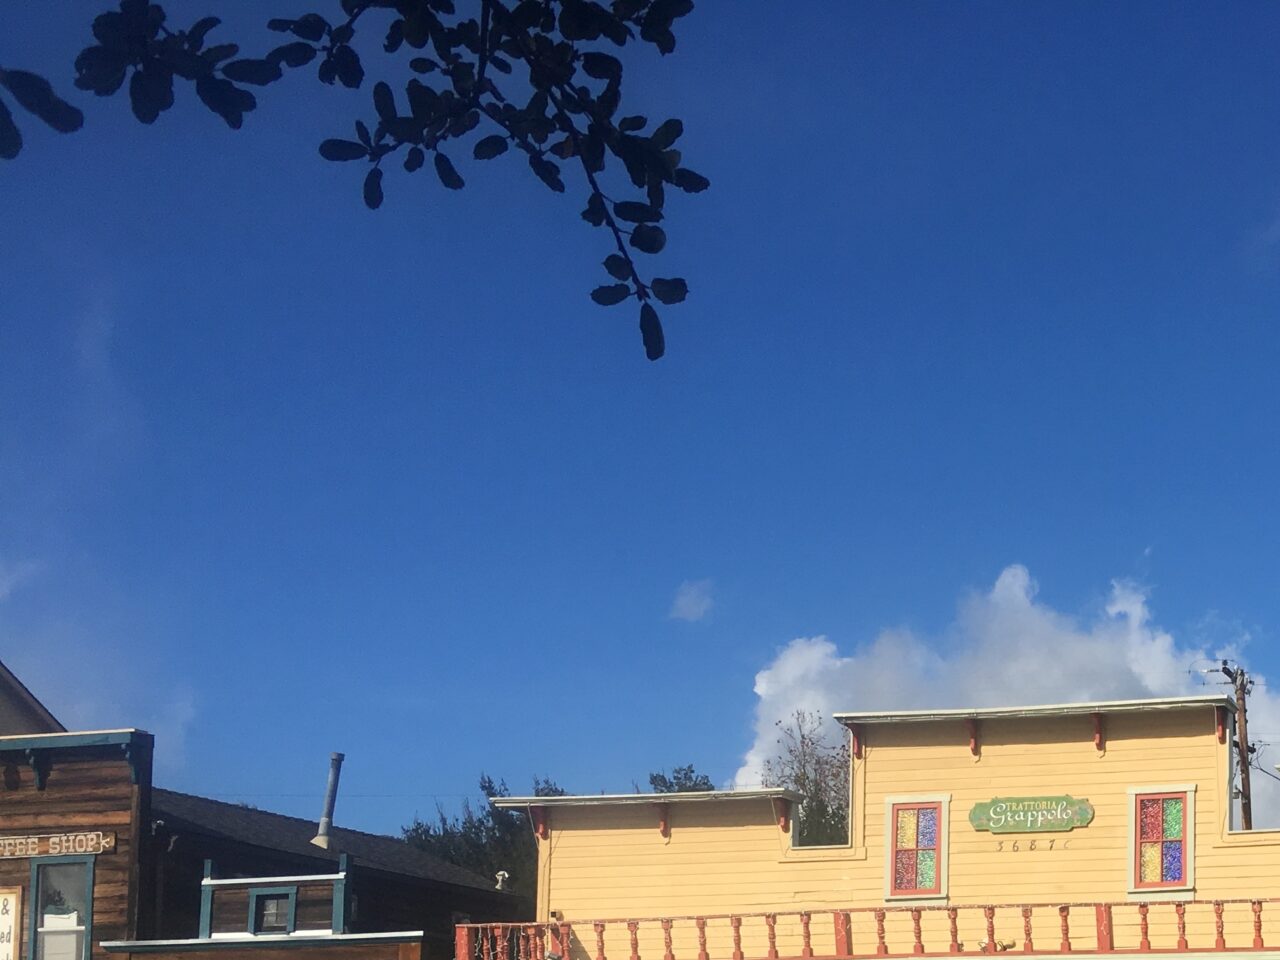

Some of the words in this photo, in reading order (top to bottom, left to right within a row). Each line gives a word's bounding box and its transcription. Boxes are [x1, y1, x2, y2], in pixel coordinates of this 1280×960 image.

[990, 801, 1072, 828] Grappolo
[1006, 801, 1057, 811] TRATTORIA
[48, 834, 97, 854] SHOP
